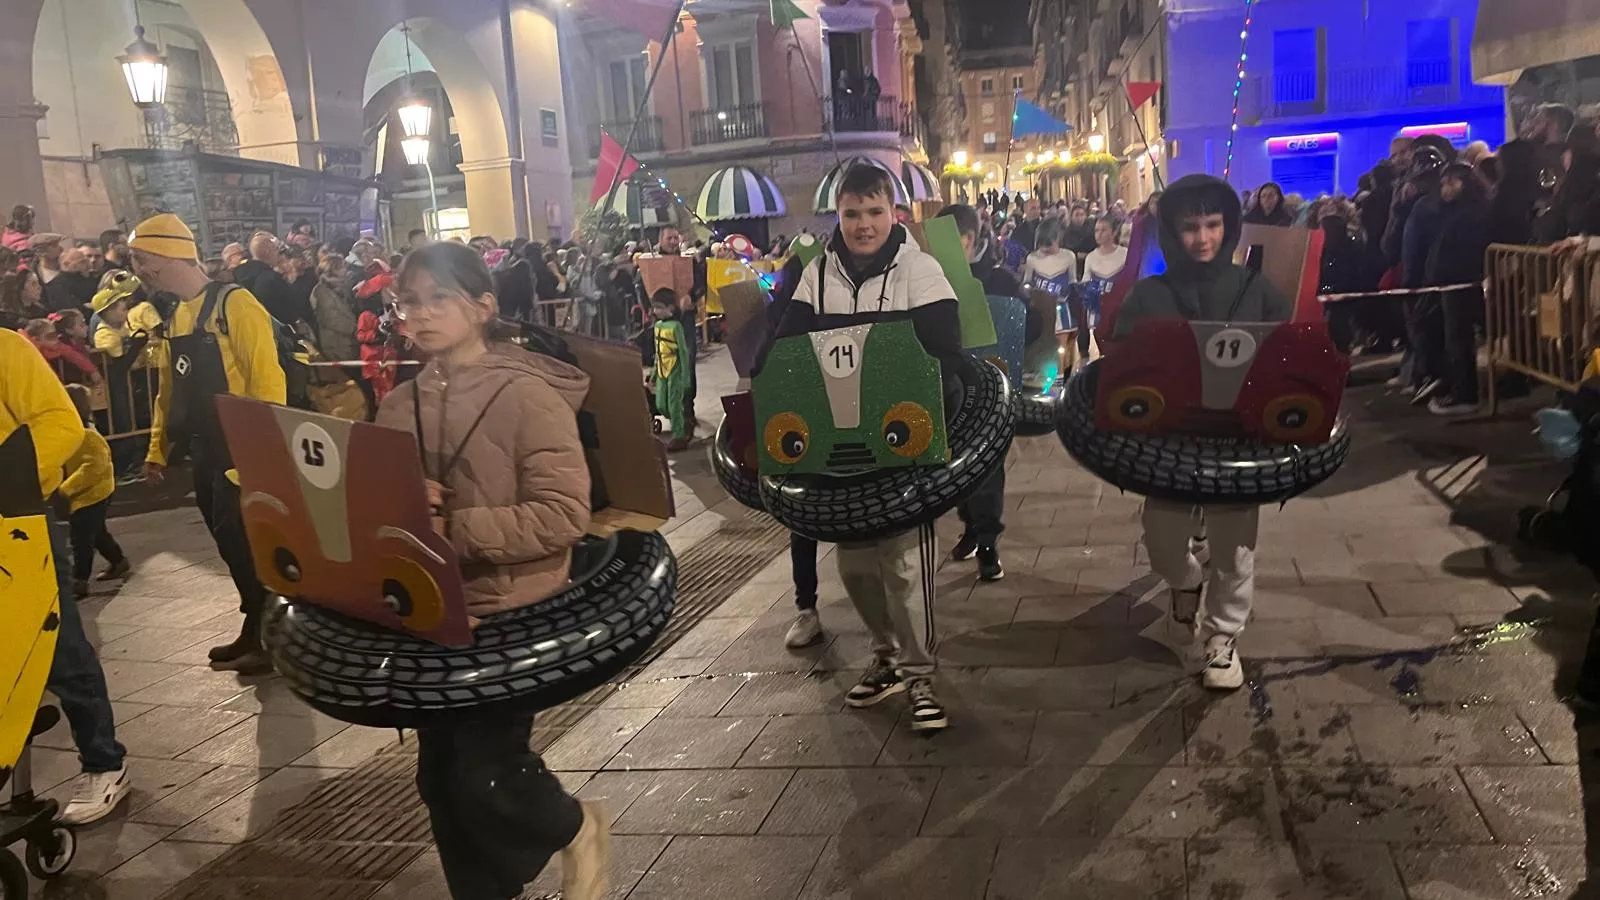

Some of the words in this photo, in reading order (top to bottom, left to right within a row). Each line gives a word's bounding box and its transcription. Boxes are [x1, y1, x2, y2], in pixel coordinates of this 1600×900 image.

[1286, 138, 1319, 152] GAES
[829, 344, 854, 369] 14
[1215, 338, 1241, 360] 19
[301, 437, 325, 467] 15
